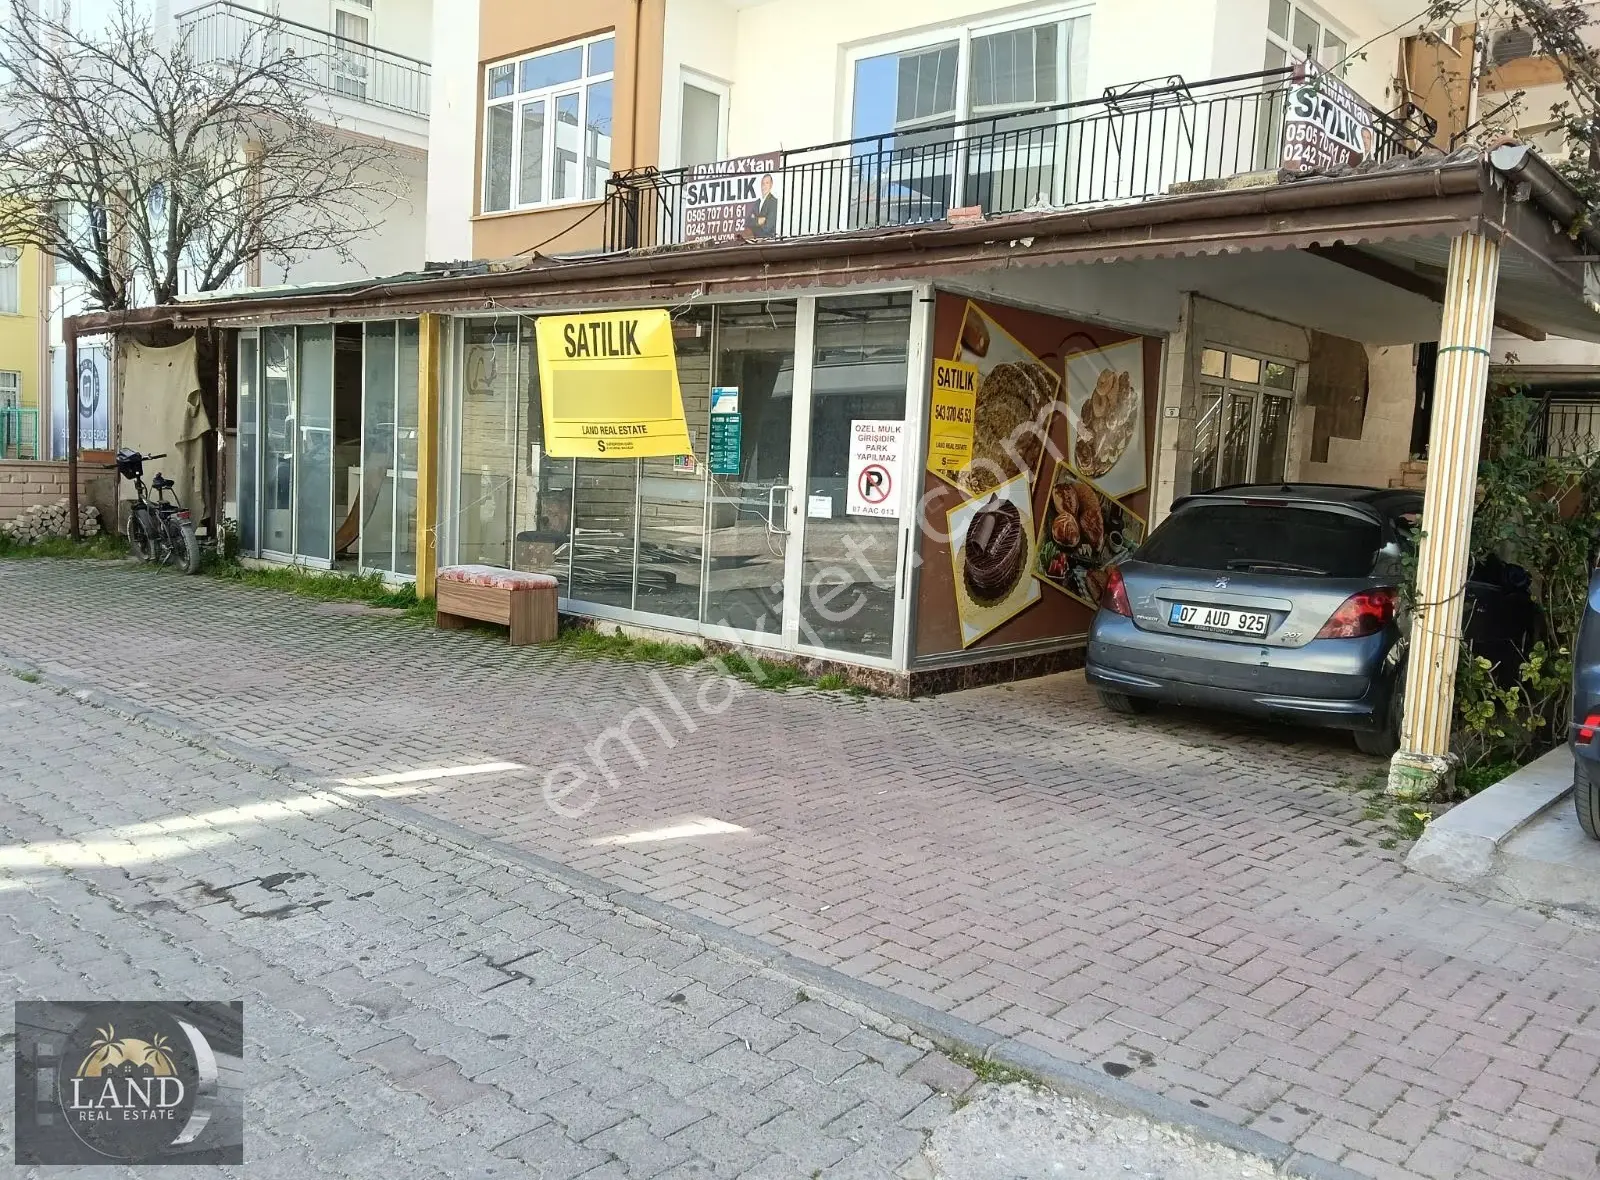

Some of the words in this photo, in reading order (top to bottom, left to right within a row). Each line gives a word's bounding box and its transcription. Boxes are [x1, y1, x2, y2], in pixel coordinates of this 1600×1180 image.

[1294, 87, 1362, 152] SATILIK
[1283, 143, 1317, 165] 0242
[1286, 123, 1319, 145] 0505
[1340, 148, 1351, 165] 61
[687, 177, 757, 206] SATILIK
[687, 208, 706, 223] 0505
[707, 206, 721, 221] 707
[723, 205, 734, 219] 01
[736, 204, 747, 218] 61
[686, 223, 706, 236] 0242
[707, 220, 721, 235] 777
[722, 219, 734, 232] 07
[735, 218, 746, 232] 52
[563, 320, 641, 358] SATILIK
[937, 366, 975, 392] SATILIK
[934, 404, 946, 421] 543
[946, 405, 957, 422] 370
[957, 407, 965, 423] 45
[965, 408, 972, 424] 53
[582, 426, 599, 435] LAND
[600, 426, 618, 435] REAL
[618, 425, 648, 435] ESTATE
[856, 453, 897, 462] YAPILMAZ
[865, 444, 888, 452] PARK
[1180, 607, 1198, 622] 07
[1204, 611, 1230, 627] AUD
[1238, 614, 1266, 632] 925
